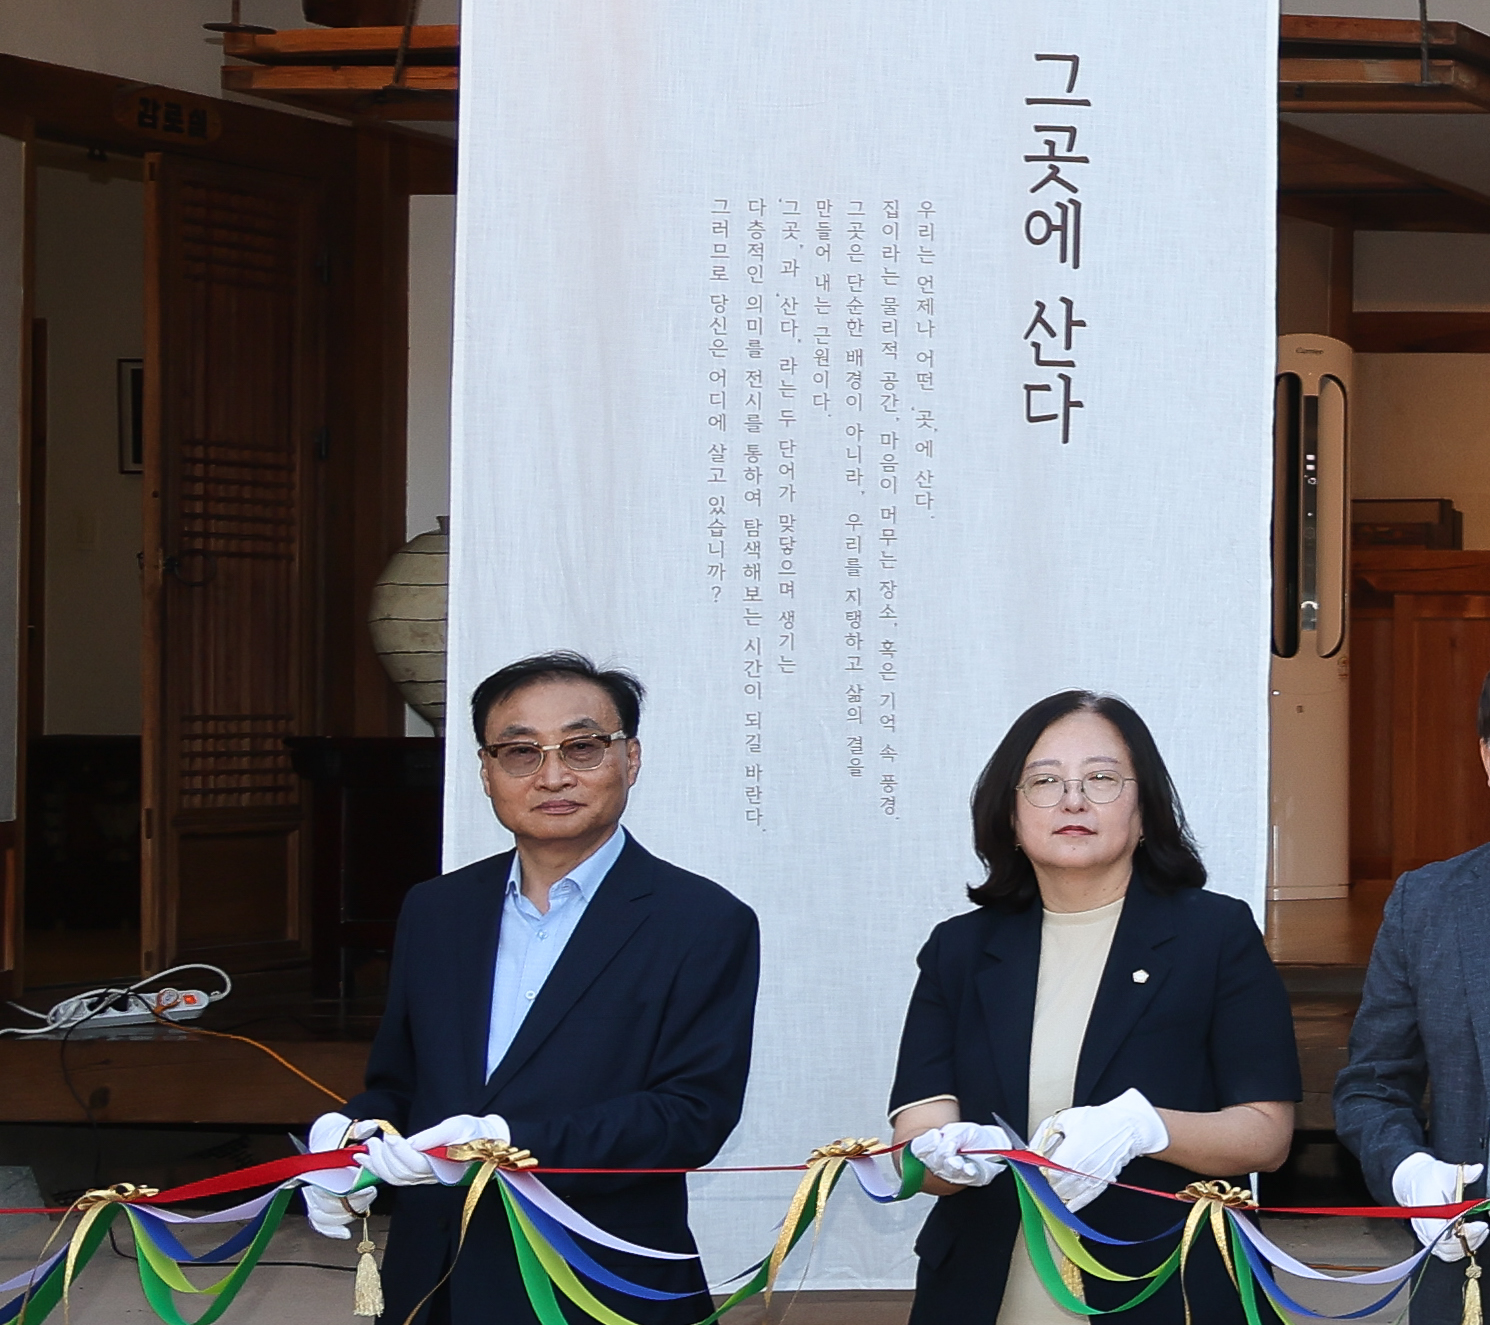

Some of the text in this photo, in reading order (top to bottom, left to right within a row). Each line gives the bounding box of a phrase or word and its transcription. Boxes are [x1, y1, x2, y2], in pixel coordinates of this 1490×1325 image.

[709, 198, 732, 282] 그러므로
[746, 197, 768, 285] 다층적인
[814, 198, 834, 263] 만들어
[846, 200, 867, 263] 그곳은
[880, 198, 901, 286] 집이라는
[916, 200, 937, 265] 우리는
[1023, 53, 1092, 445] 그곳에 산다
[707, 293, 730, 359] 당신은
[744, 294, 765, 359] 의미를
[813, 272, 832, 316] 내는
[845, 273, 866, 338] 단순한
[916, 274, 936, 339] 언제나
[880, 296, 901, 361] 물리적
[707, 367, 727, 433] 어디에
[743, 368, 764, 434] 전시를
[845, 347, 864, 413] 배경이
[915, 348, 935, 391] 어떤
[777, 409, 797, 429] 두
[706, 442, 728, 483] 살고
[742, 443, 764, 508] 통하여
[778, 438, 798, 503] 단어가
[878, 430, 900, 495] 마음이
[777, 513, 798, 600] 맞닿으며
[843, 513, 864, 578] 우리를
[878, 505, 899, 570] 머무는
[742, 517, 764, 627] 탐색해보는
[776, 609, 797, 674] 생기는
[843, 586, 865, 671] 지탱하고
[877, 639, 898, 682] 혹은
[743, 636, 764, 701] 시간이
[744, 710, 762, 754] 되길
[844, 683, 865, 725] 삶의
[879, 691, 897, 734] 기억
[846, 735, 865, 778] 결을
[878, 743, 899, 763] 속
